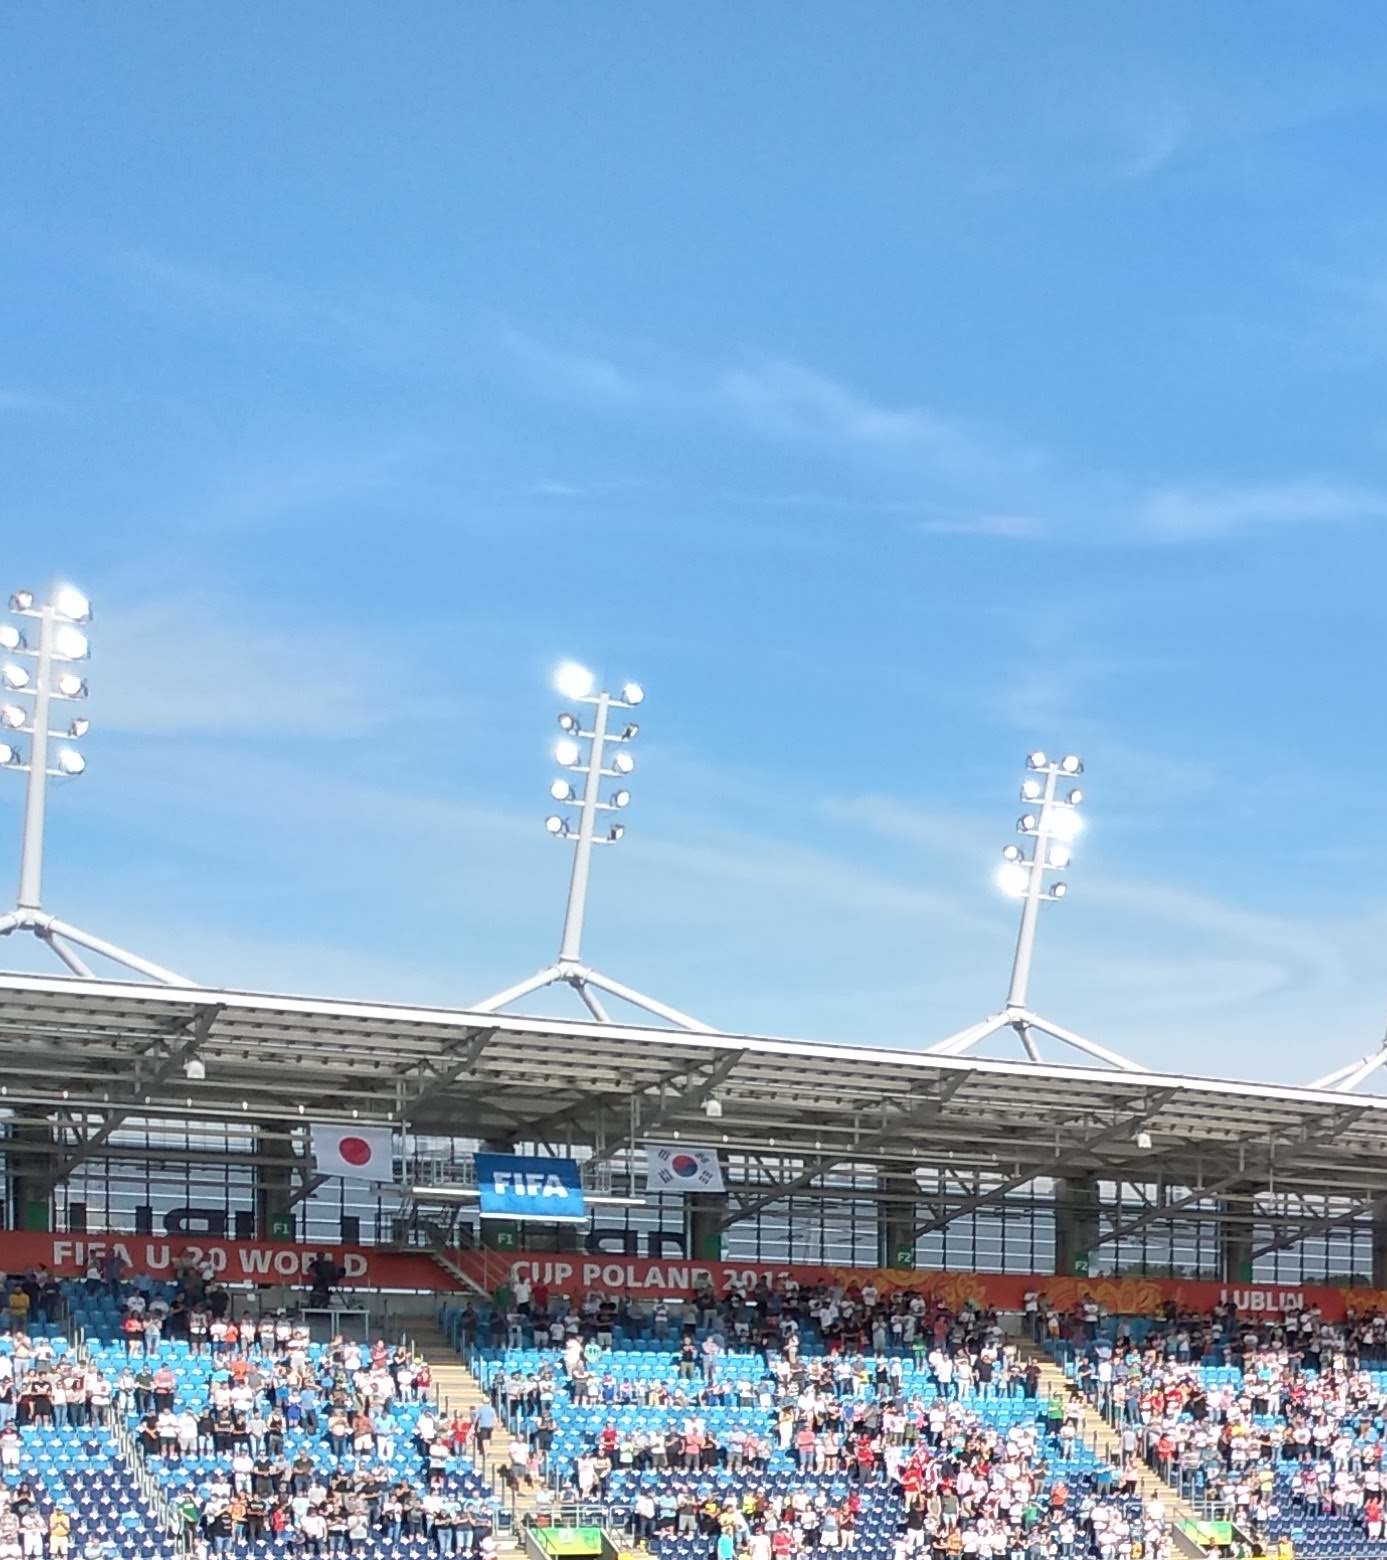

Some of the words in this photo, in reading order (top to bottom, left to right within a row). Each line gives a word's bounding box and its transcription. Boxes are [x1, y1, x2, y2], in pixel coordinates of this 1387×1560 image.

[492, 1171, 569, 1198] FIFA
[273, 1223, 289, 1234] F1
[239, 1248, 368, 1278] WORD
[511, 1260, 573, 1286] CUP
[722, 1268, 792, 1292] 201
